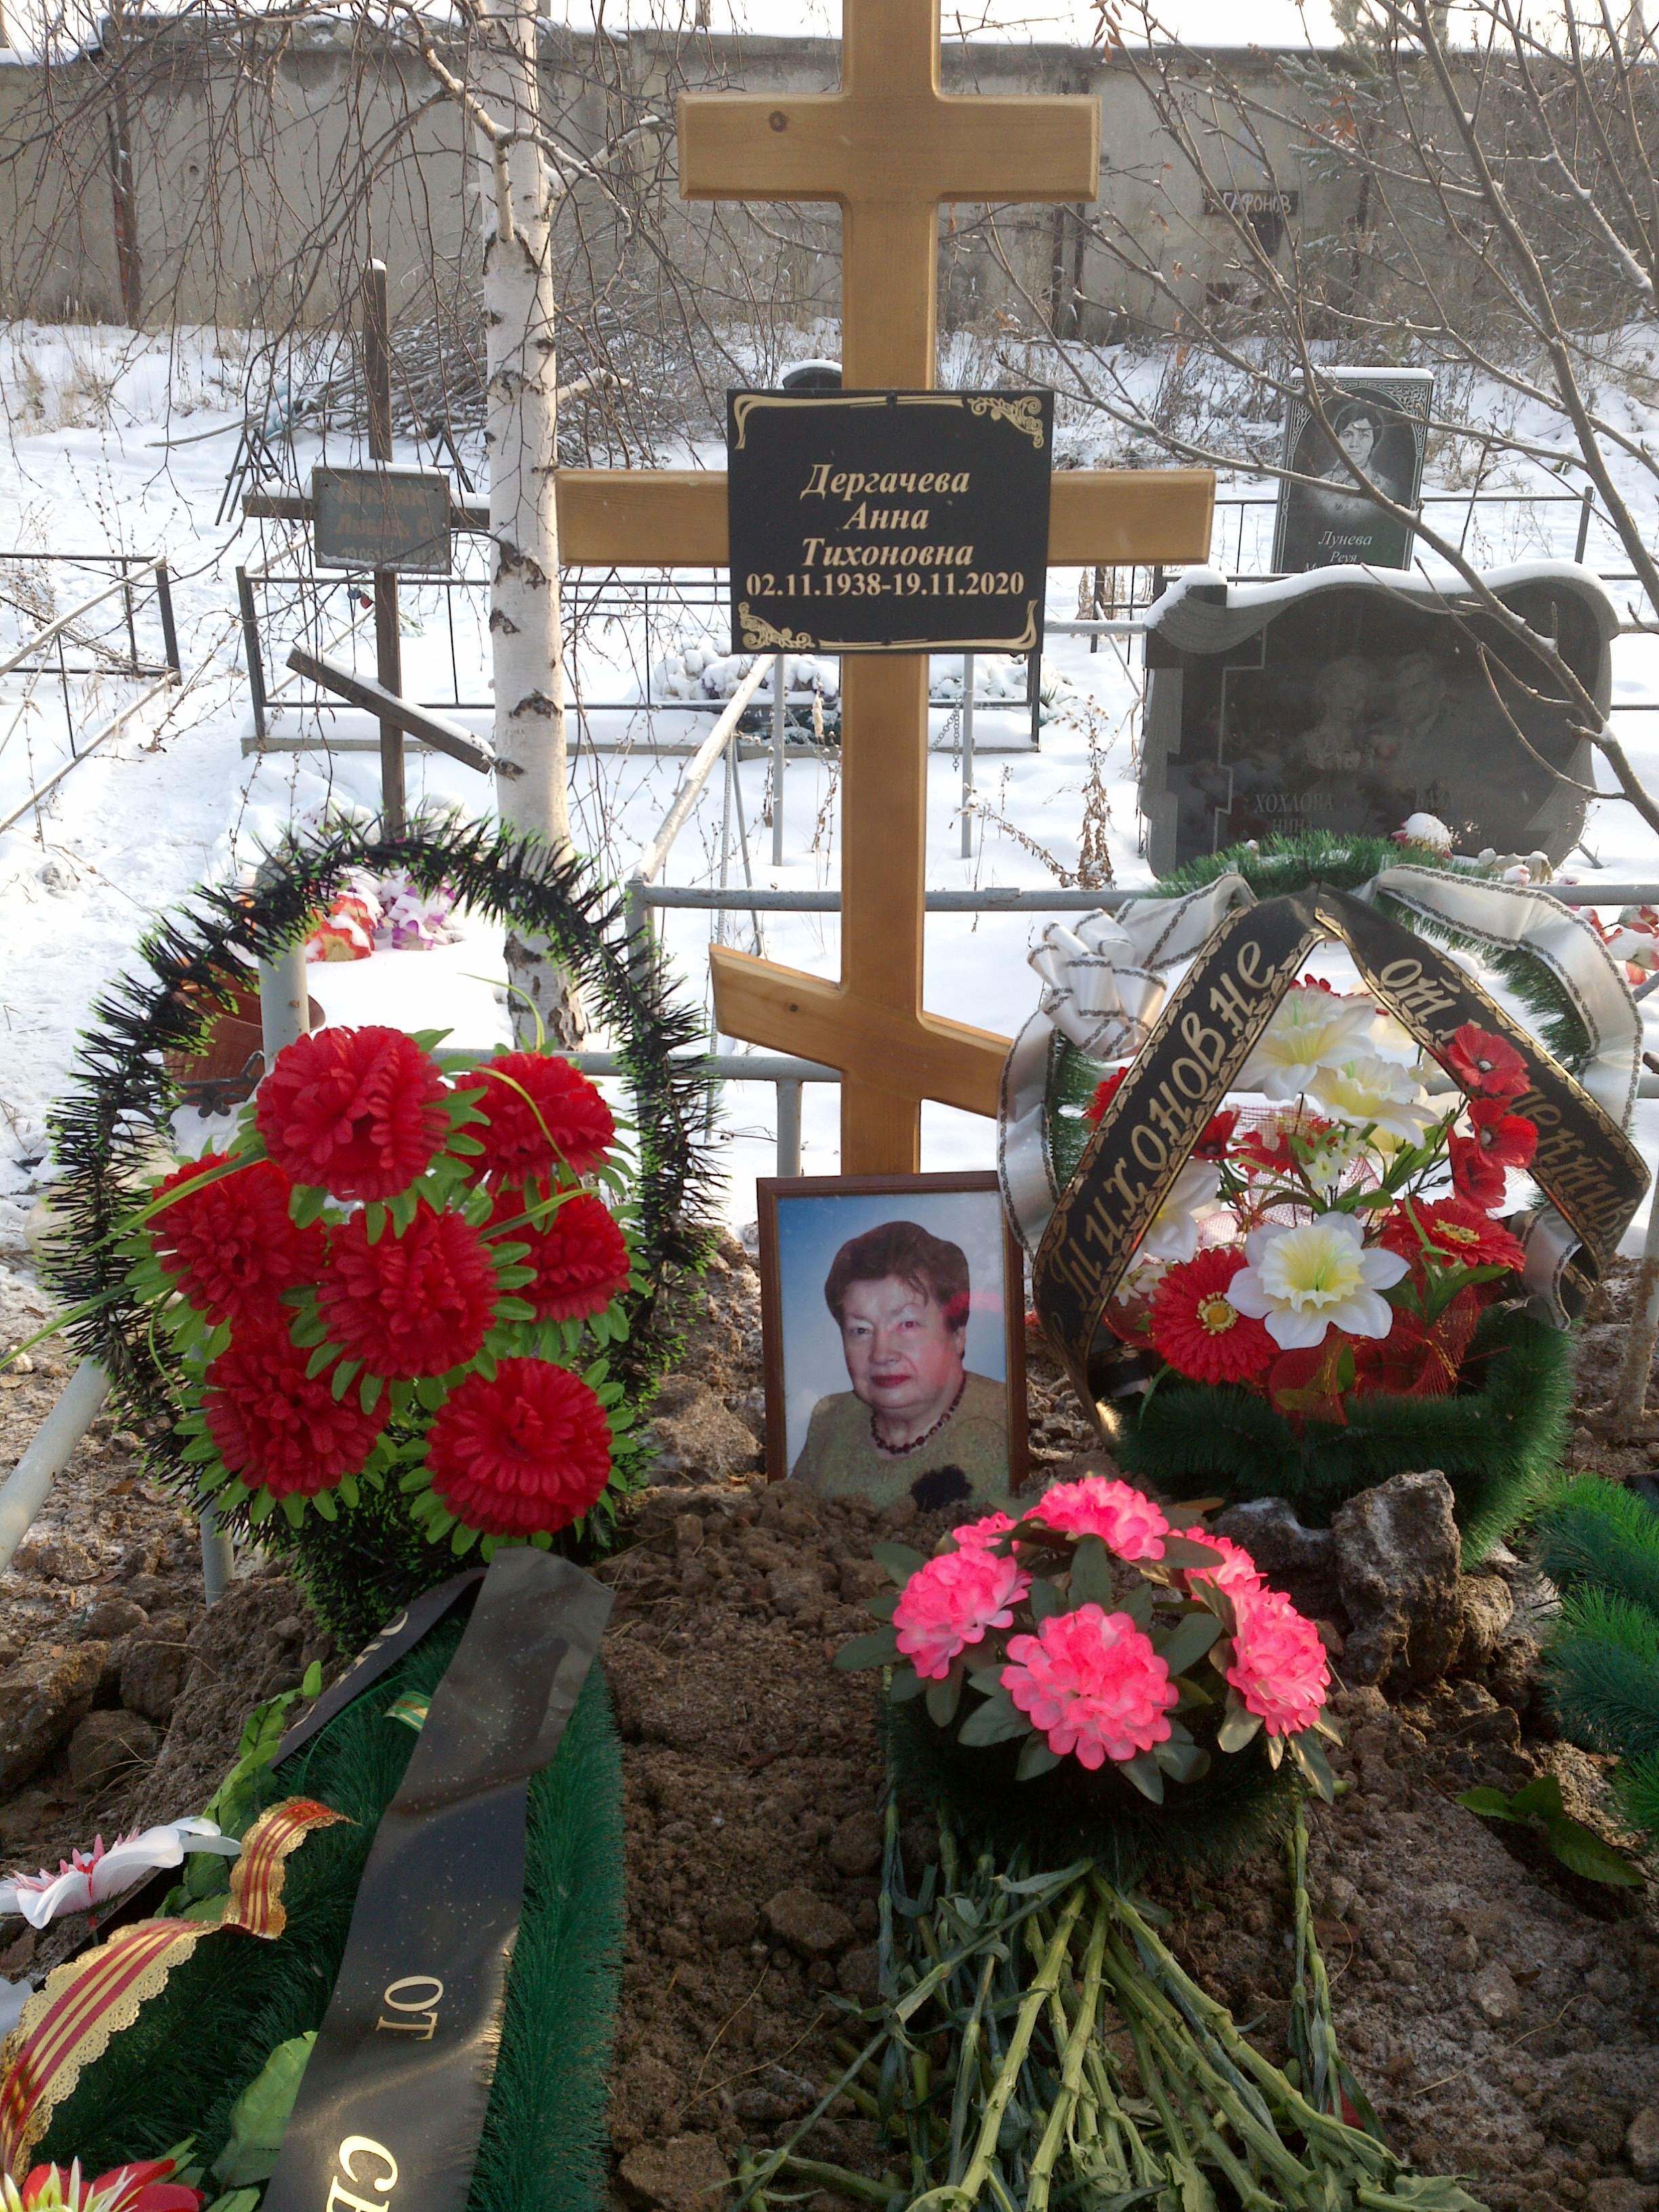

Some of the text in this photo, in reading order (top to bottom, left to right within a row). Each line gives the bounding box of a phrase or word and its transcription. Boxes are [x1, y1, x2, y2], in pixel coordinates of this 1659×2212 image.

[1210, 192, 1292, 214] ГАФОНОВ
[800, 463, 970, 501] Дергачева
[842, 501, 930, 531] Анна
[802, 537, 974, 567] Тихоновна
[1318, 531, 1373, 548] Лунева
[746, 571, 1025, 597] 02.11.1938-19.11.2020
[1254, 792, 1334, 813] ХОХЛОВА
[375, 1975, 444, 2041] ОТ
